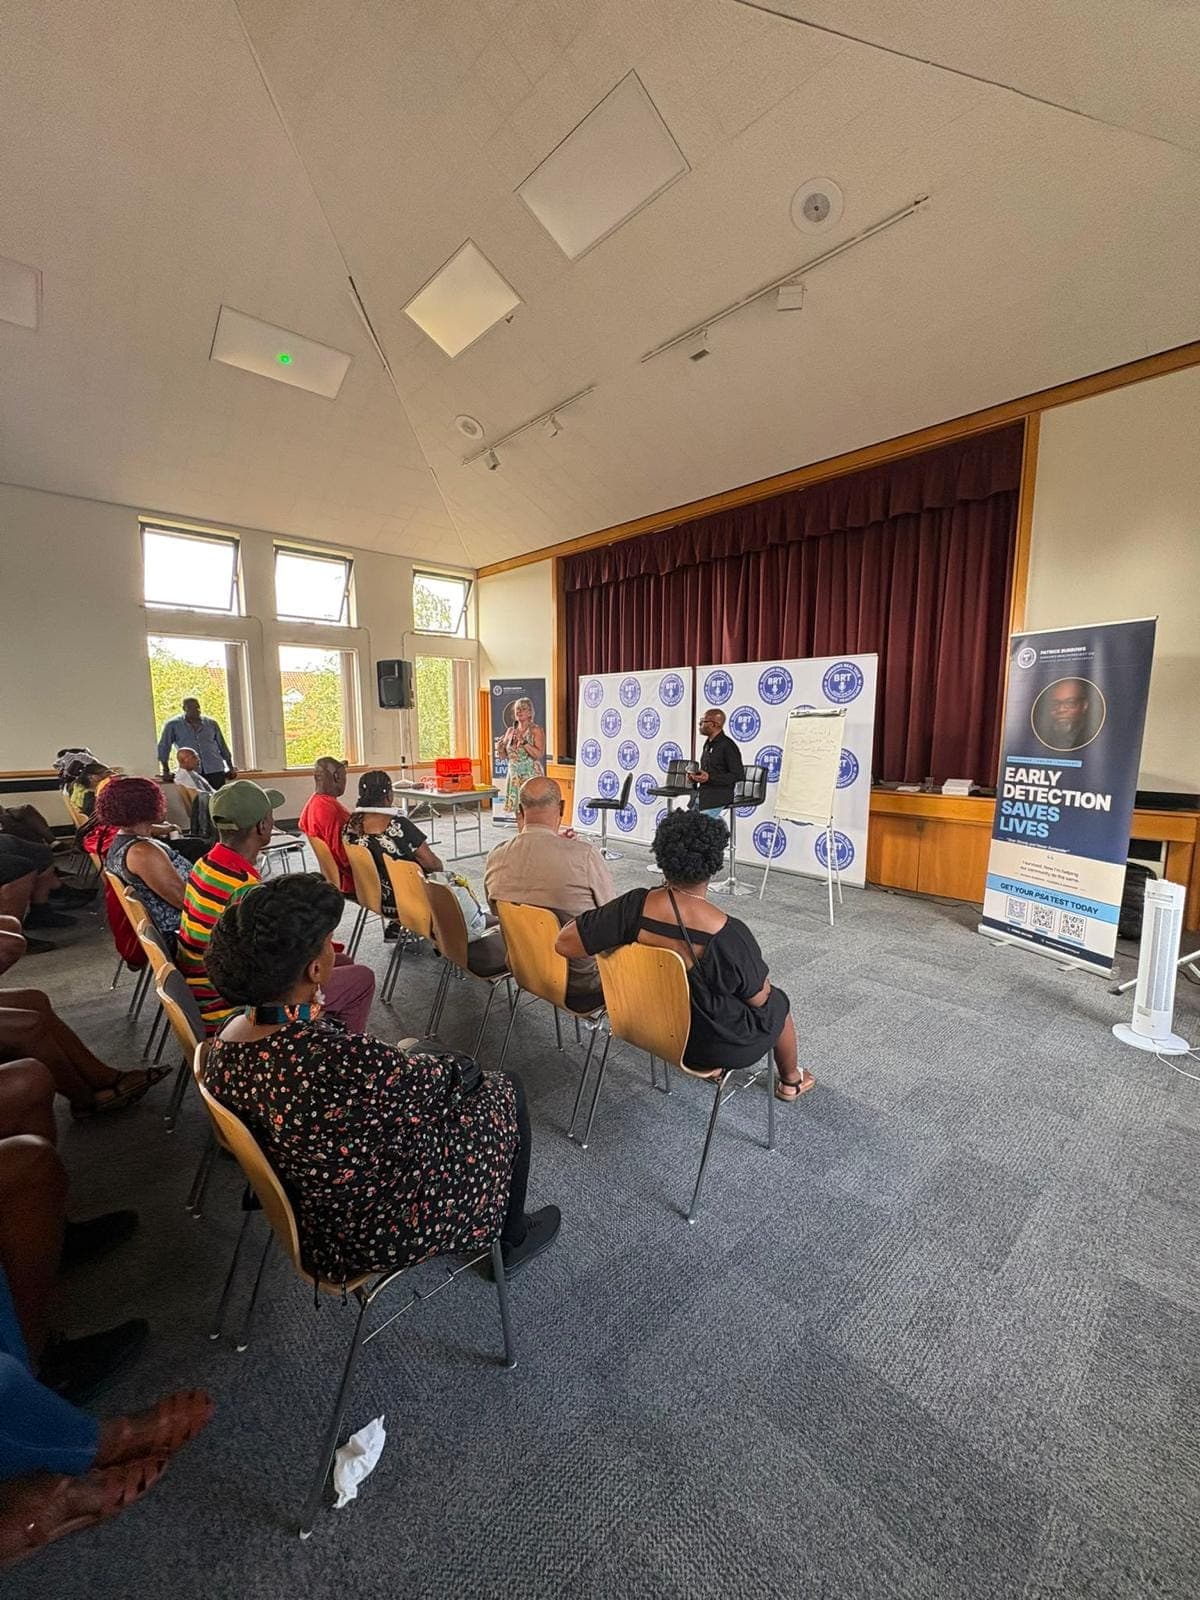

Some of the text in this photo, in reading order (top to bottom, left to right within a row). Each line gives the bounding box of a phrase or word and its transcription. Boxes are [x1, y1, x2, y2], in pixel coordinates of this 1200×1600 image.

[768, 677, 782, 685] BRT
[834, 673, 851, 682] BRT
[1004, 767, 1062, 786] EARLY
[1003, 784, 1112, 811] DETECTION
[1001, 800, 1060, 822] SAVES
[1000, 816, 1049, 838] LIVES
[1000, 883, 1013, 891] GET
[1014, 886, 1034, 896] YOUR
[1034, 892, 1049, 901] PSA
[1050, 896, 1070, 906] TEST
[1071, 901, 1099, 914] TODAY
